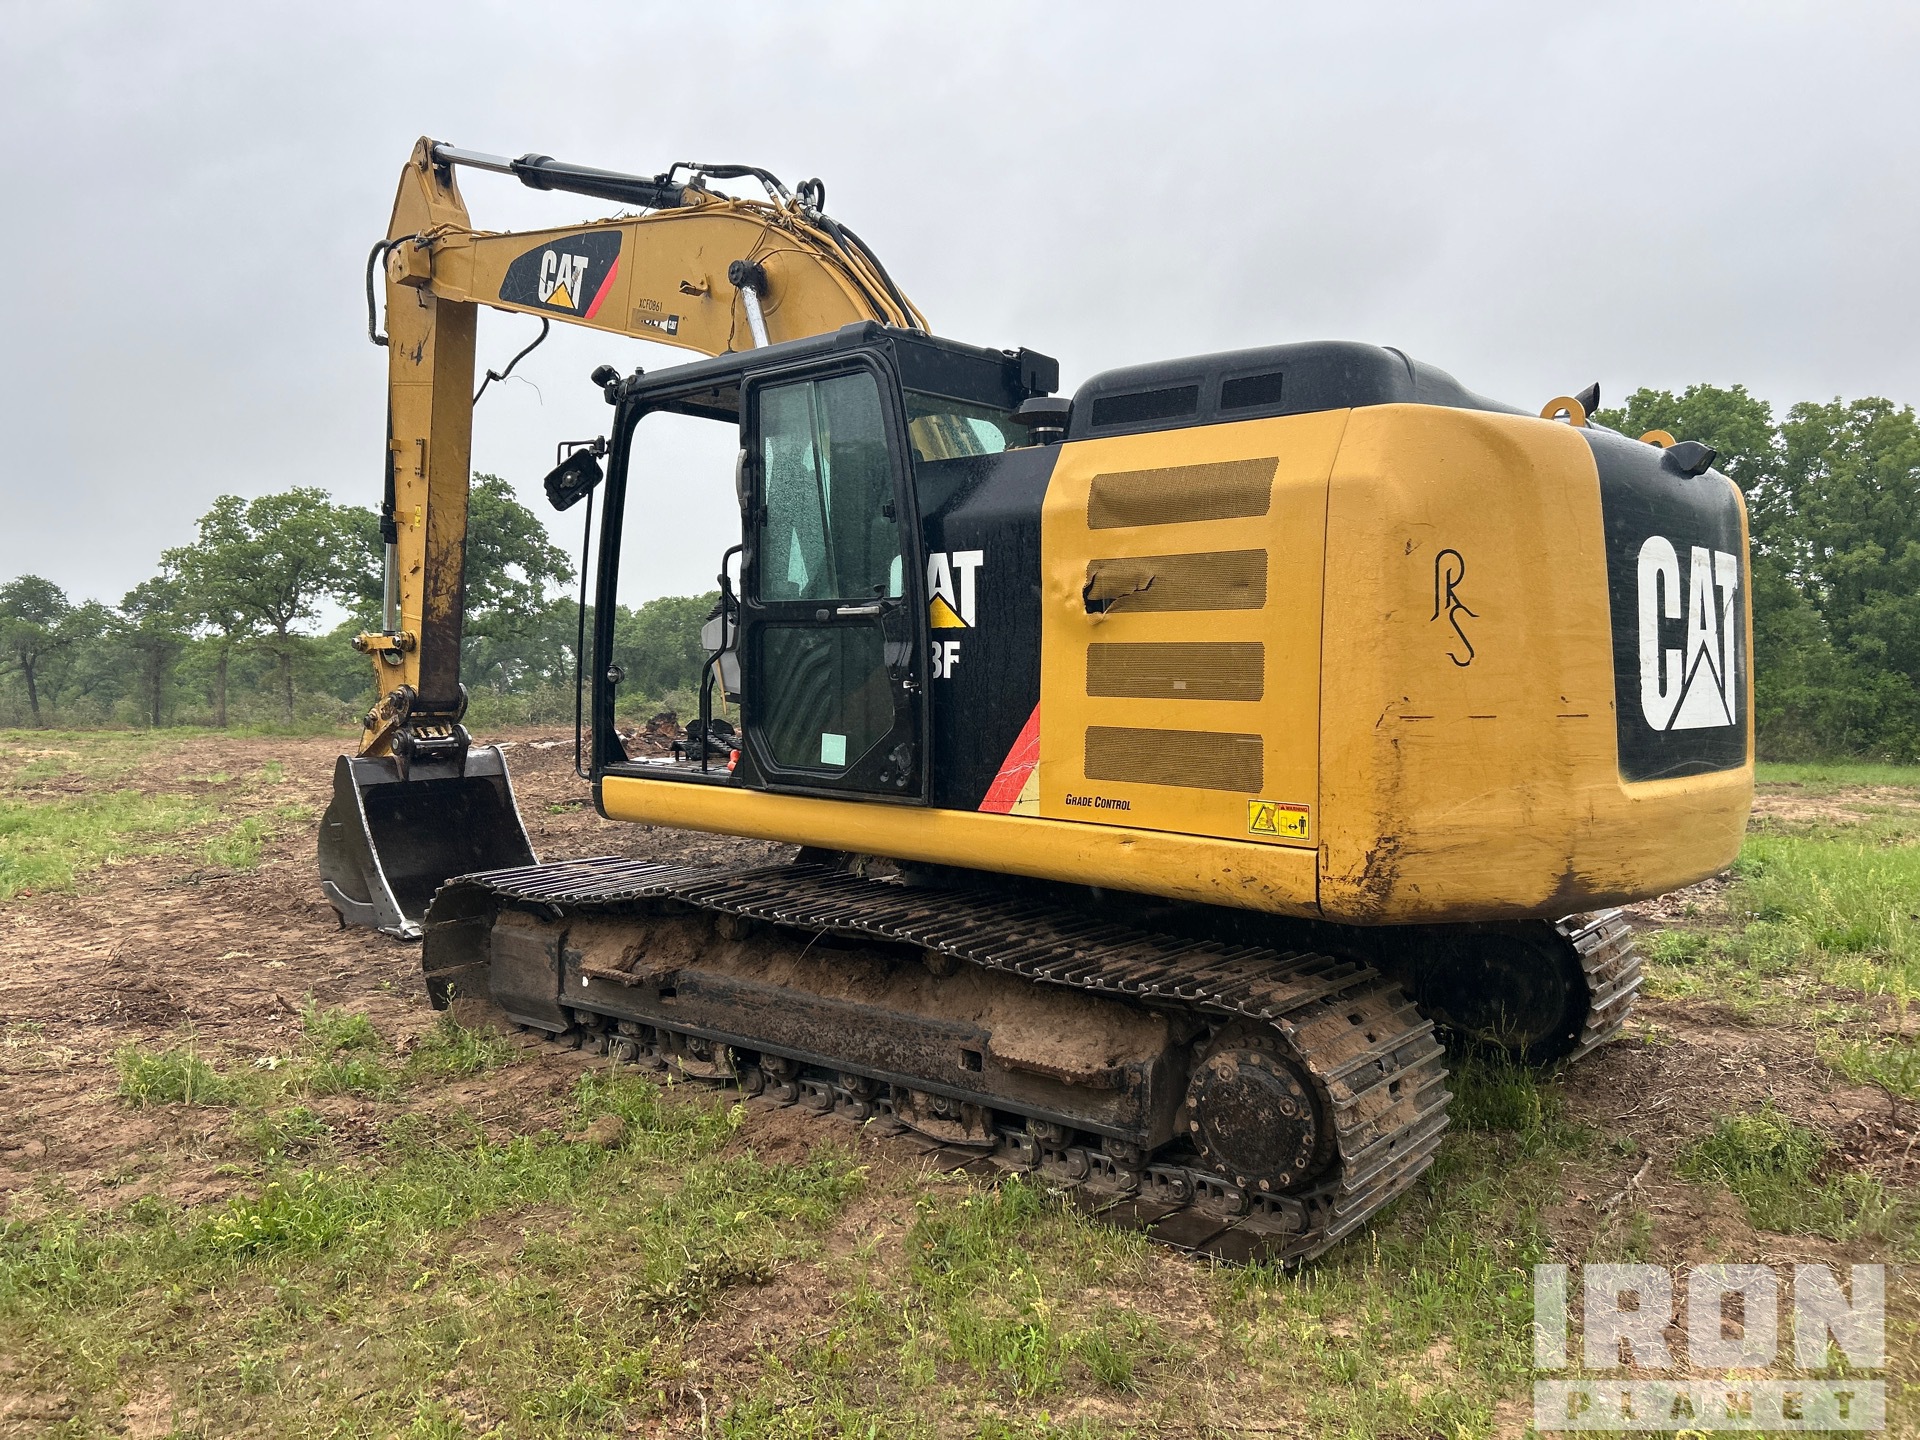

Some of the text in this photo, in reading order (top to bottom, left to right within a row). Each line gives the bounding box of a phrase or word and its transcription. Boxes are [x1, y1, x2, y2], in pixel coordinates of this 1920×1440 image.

[538, 250, 589, 310] CAT
[668, 320, 678, 330] CAT
[1637, 535, 1738, 731] CAT
